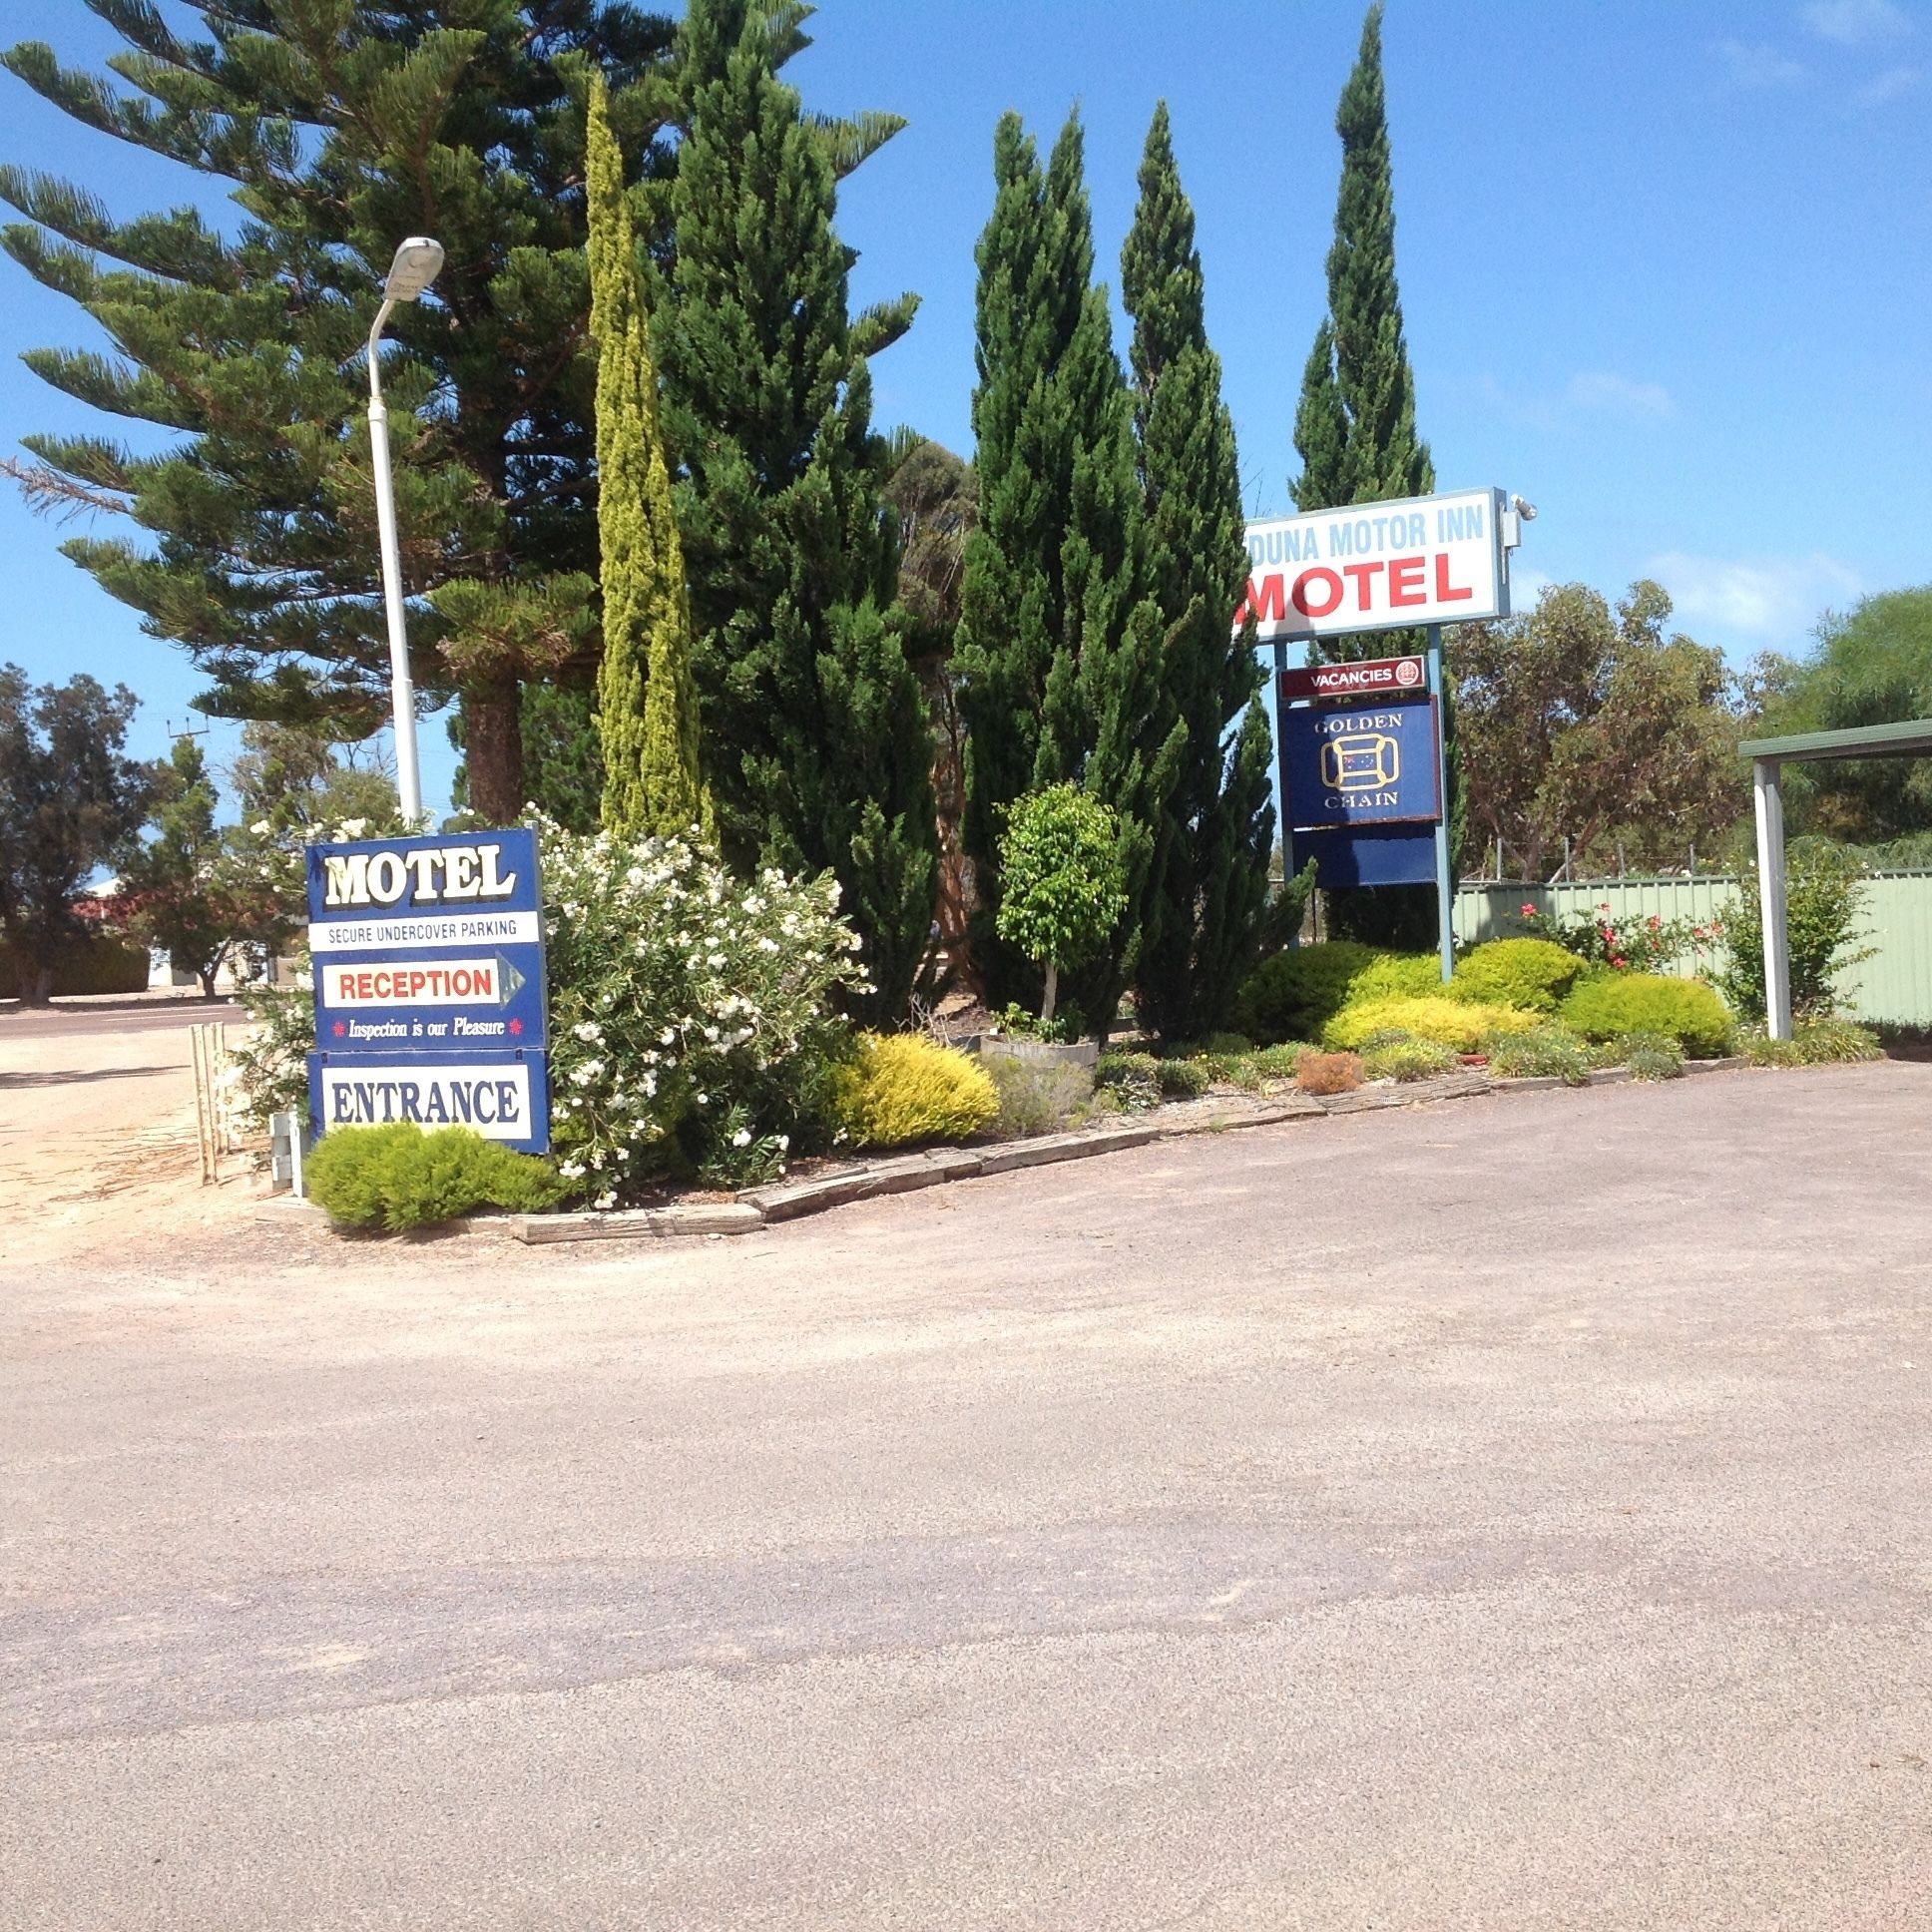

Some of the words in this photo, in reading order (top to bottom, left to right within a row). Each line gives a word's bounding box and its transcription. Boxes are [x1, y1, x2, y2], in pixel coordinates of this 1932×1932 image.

[1243, 527, 1319, 567] DUNA
[1329, 517, 1427, 557] MOTOR
[1438, 504, 1484, 543] INN
[1234, 553, 1472, 625] MOTEL
[1310, 668, 1392, 687] VACANCIES
[1314, 714, 1402, 733] GOLDEN
[1324, 791, 1397, 808] CHAIN
[323, 844, 517, 907] MOTEL
[328, 928, 372, 943] SECURE
[377, 923, 456, 941] UNDERCOVER
[461, 919, 517, 937] PARKING
[339, 969, 492, 999] RECEPTION
[349, 1018, 408, 1041] Inspection
[412, 1018, 423, 1036] is
[427, 1023, 448, 1036] our
[453, 1016, 505, 1036] Pleasure
[331, 1080, 519, 1124] ENTRANCE
